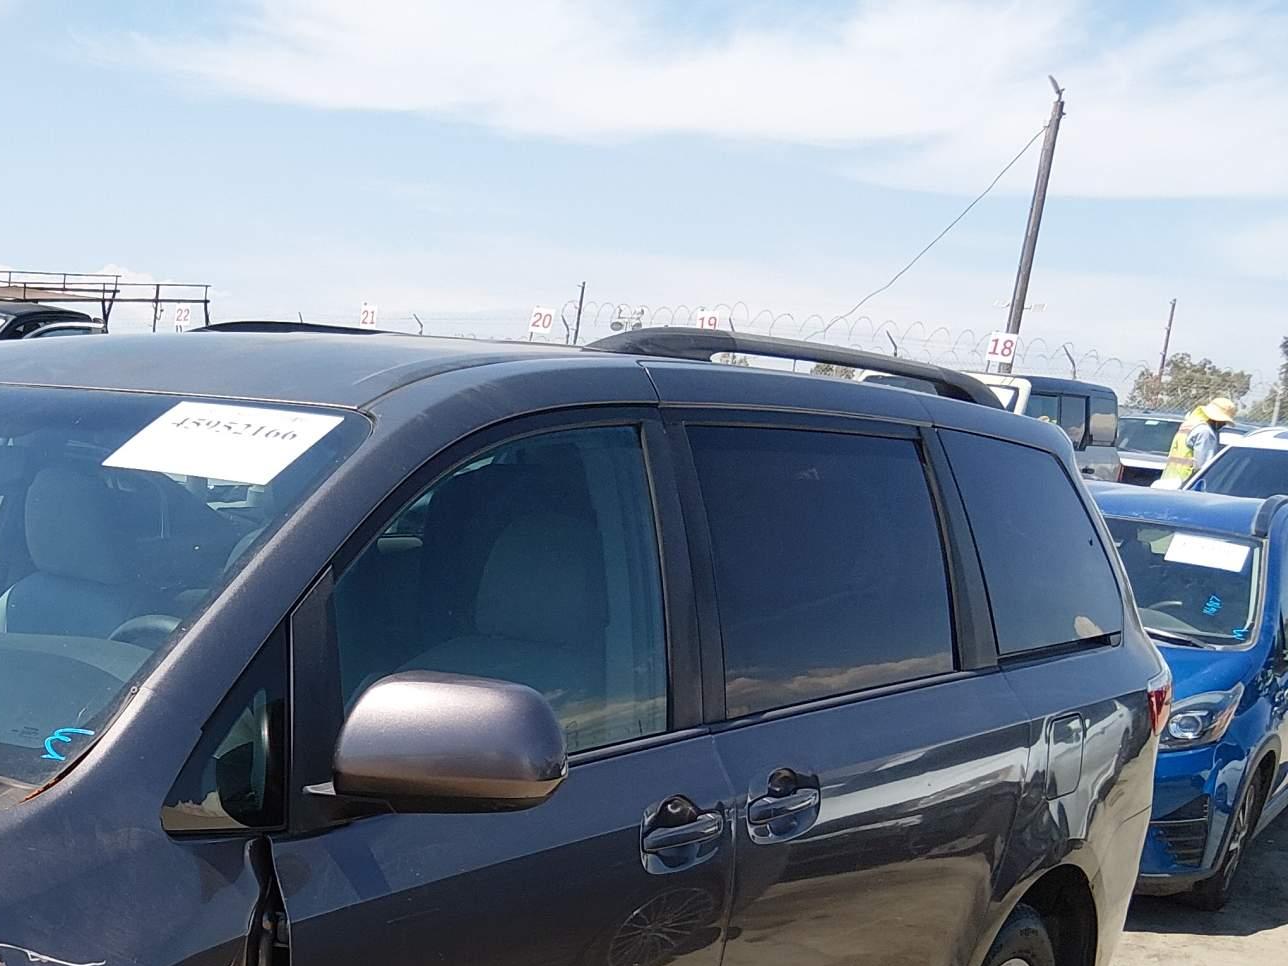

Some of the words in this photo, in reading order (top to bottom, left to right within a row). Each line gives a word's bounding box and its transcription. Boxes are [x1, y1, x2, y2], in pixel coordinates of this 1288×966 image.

[175, 308, 190, 322] 22
[360, 309, 376, 325] 21
[531, 312, 553, 329] 20
[698, 316, 718, 331] 19
[988, 337, 1014, 357] 18
